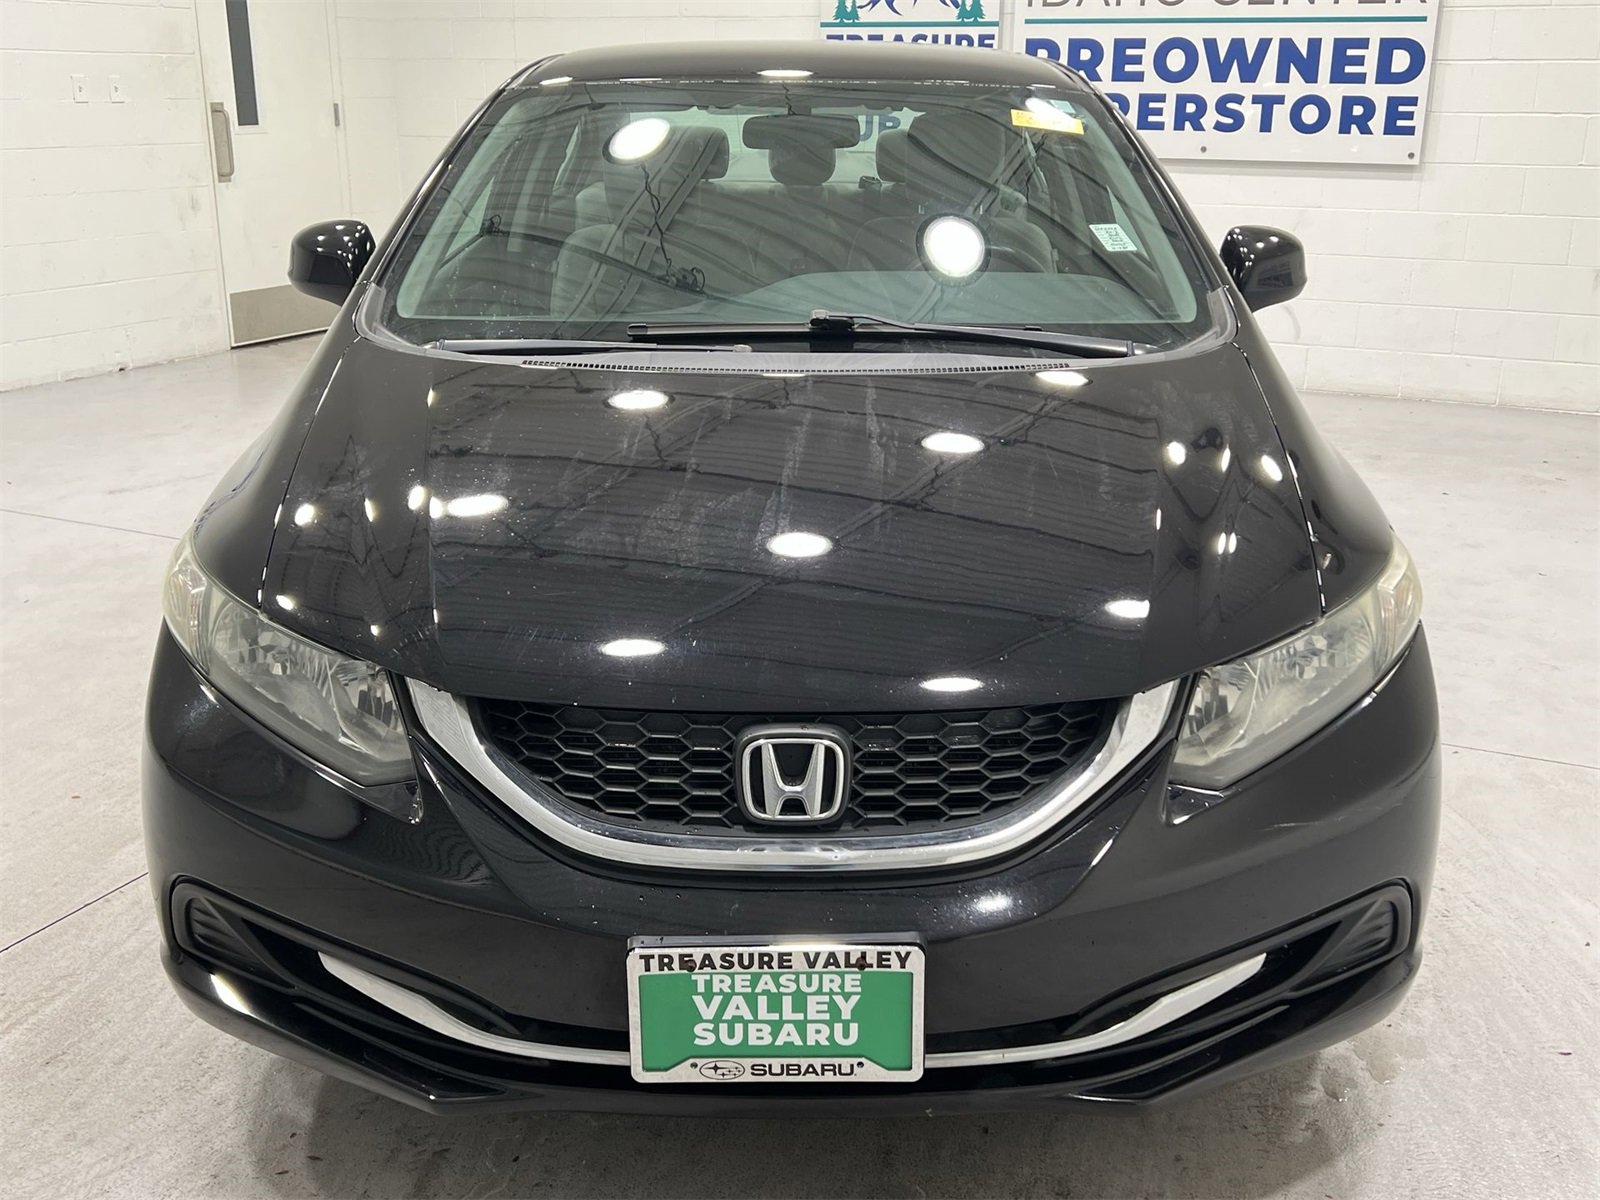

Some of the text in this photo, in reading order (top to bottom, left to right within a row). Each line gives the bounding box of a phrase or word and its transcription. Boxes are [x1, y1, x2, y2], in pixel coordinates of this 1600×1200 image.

[639, 951, 912, 973] TREASURE VALLEY
[692, 973, 862, 993] TREASURE
[691, 994, 861, 1021] VALLEY
[693, 1022, 859, 1046] SUBARU
[750, 1063, 856, 1077] SUBARU
